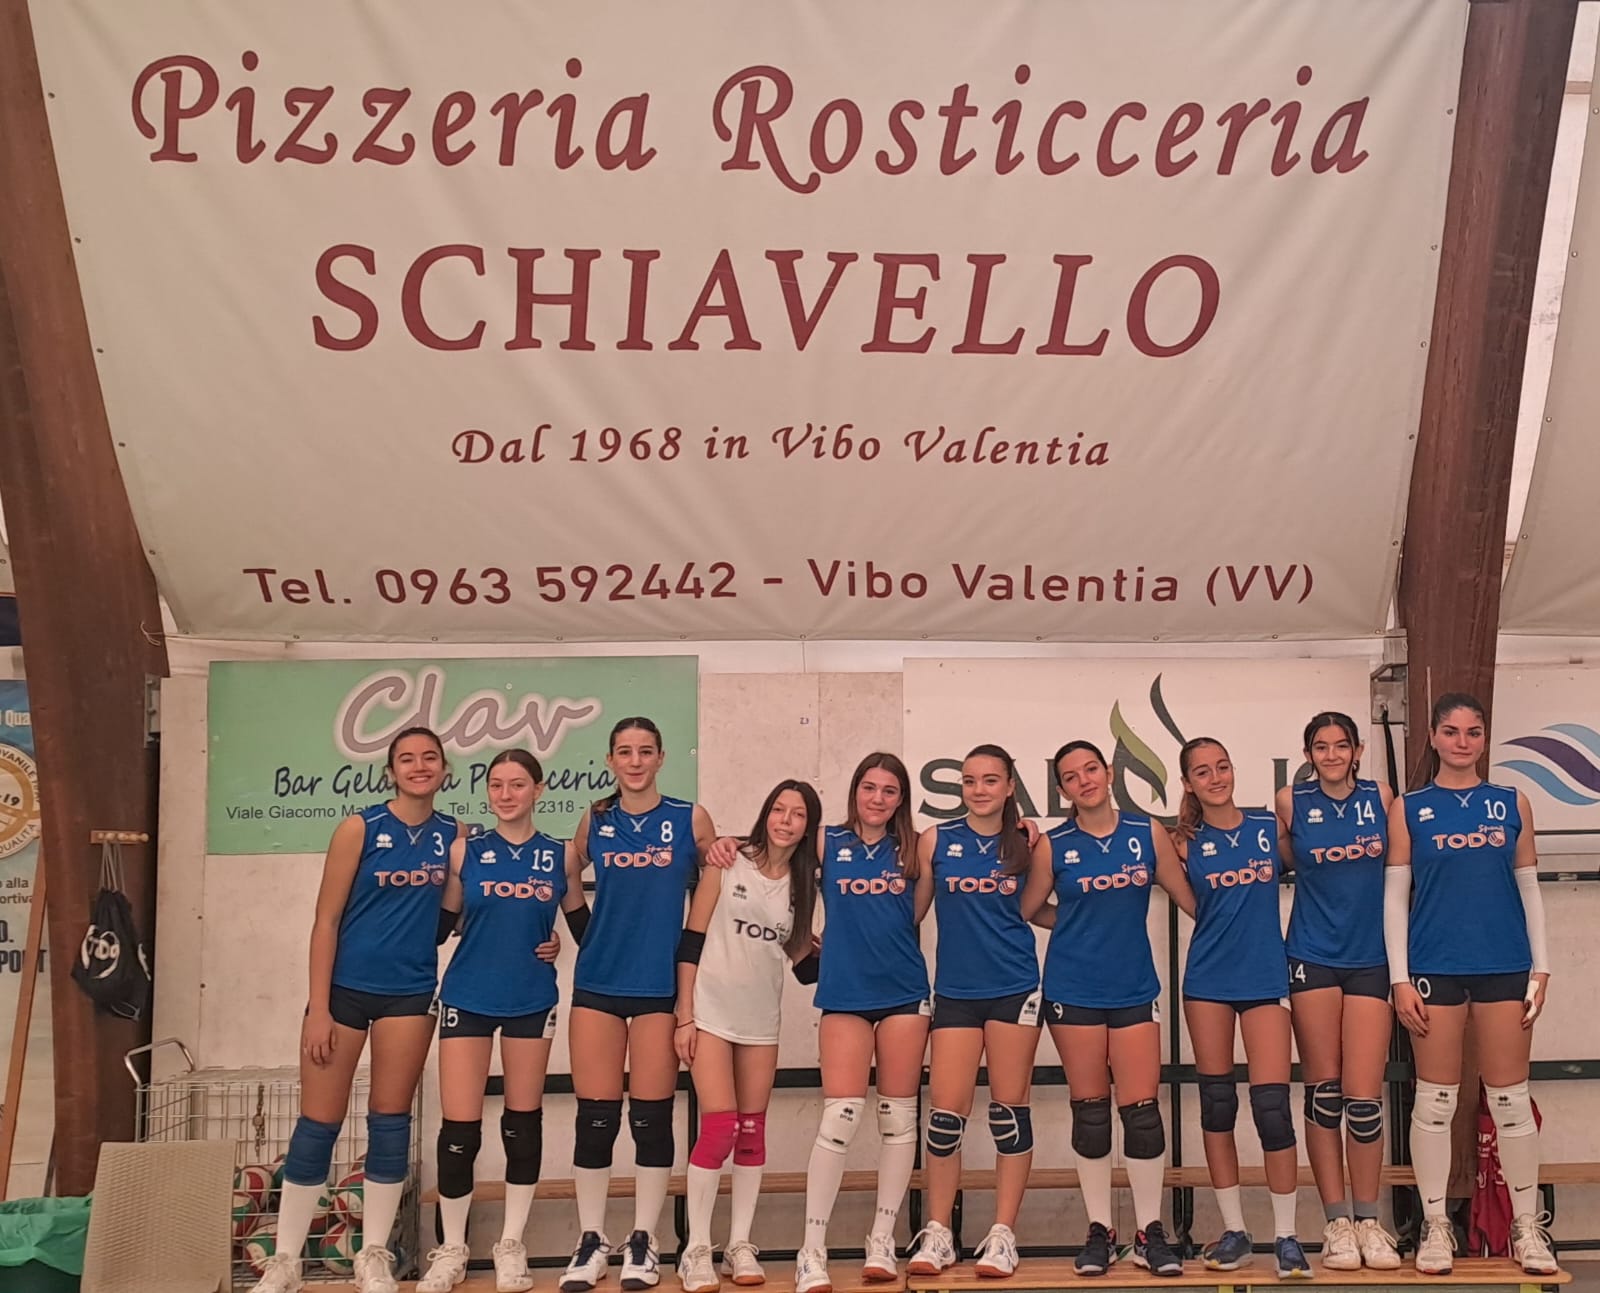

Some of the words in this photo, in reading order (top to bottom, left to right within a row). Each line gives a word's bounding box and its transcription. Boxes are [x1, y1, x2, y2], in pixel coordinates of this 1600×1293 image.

[132, 50, 657, 171] Pizzeria
[713, 64, 1370, 194] Rosticceria
[312, 244, 1220, 358] SCHIAVELLO
[452, 424, 552, 463] Dal
[570, 427, 682, 462] 1968
[704, 426, 749, 459] in
[772, 423, 880, 460] Vibo
[904, 426, 1109, 466] Valentia
[243, 568, 351, 604] Tel.
[376, 568, 511, 605] 0963
[536, 562, 736, 602] 592442
[807, 559, 927, 598] Vibo
[952, 564, 1177, 602] Valentia
[1207, 564, 1313, 606] (VV)
[5, 709, 31, 727] Qua
[274, 766, 322, 797] Bar
[332, 764, 460, 798] Gelaa
[470, 760, 617, 794] Pceria
[226, 806, 263, 819] Viale
[268, 805, 336, 819] Giacomo
[448, 802, 473, 815] Tel.
[1354, 800, 1376, 825] 14
[1484, 799, 1506, 820] 10
[661, 821, 673, 842] 8
[1257, 829, 1270, 853] 6
[432, 832, 445, 856] 3
[1128, 837, 1141, 861] 9
[531, 848, 554, 872] 15
[441, 1006, 459, 1028] 15
